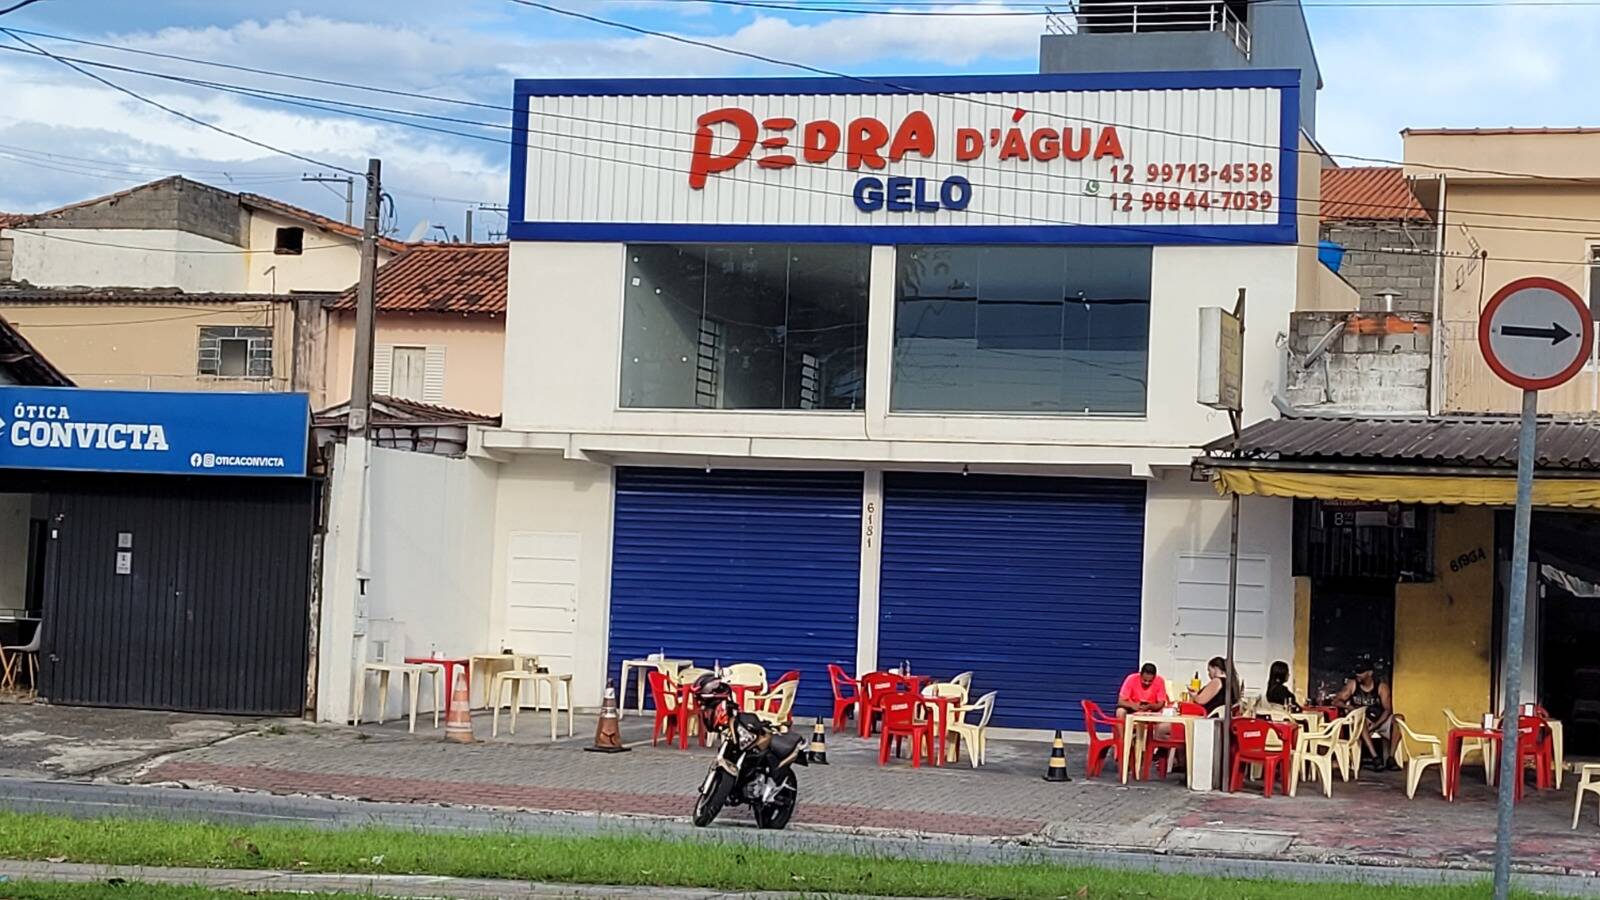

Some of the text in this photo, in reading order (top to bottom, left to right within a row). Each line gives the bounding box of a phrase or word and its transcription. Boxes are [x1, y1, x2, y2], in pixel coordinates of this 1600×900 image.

[689, 107, 1125, 190] PEDRA D'ÁGUA
[1110, 162, 1273, 183] 12 99713-4538
[853, 175, 973, 213] GELO
[1110, 190, 1272, 213] 12 98844-7039
[14, 402, 70, 419] ÓTICA
[11, 420, 169, 451] CONVICTA
[215, 456, 285, 467] OTICACONVICTA
